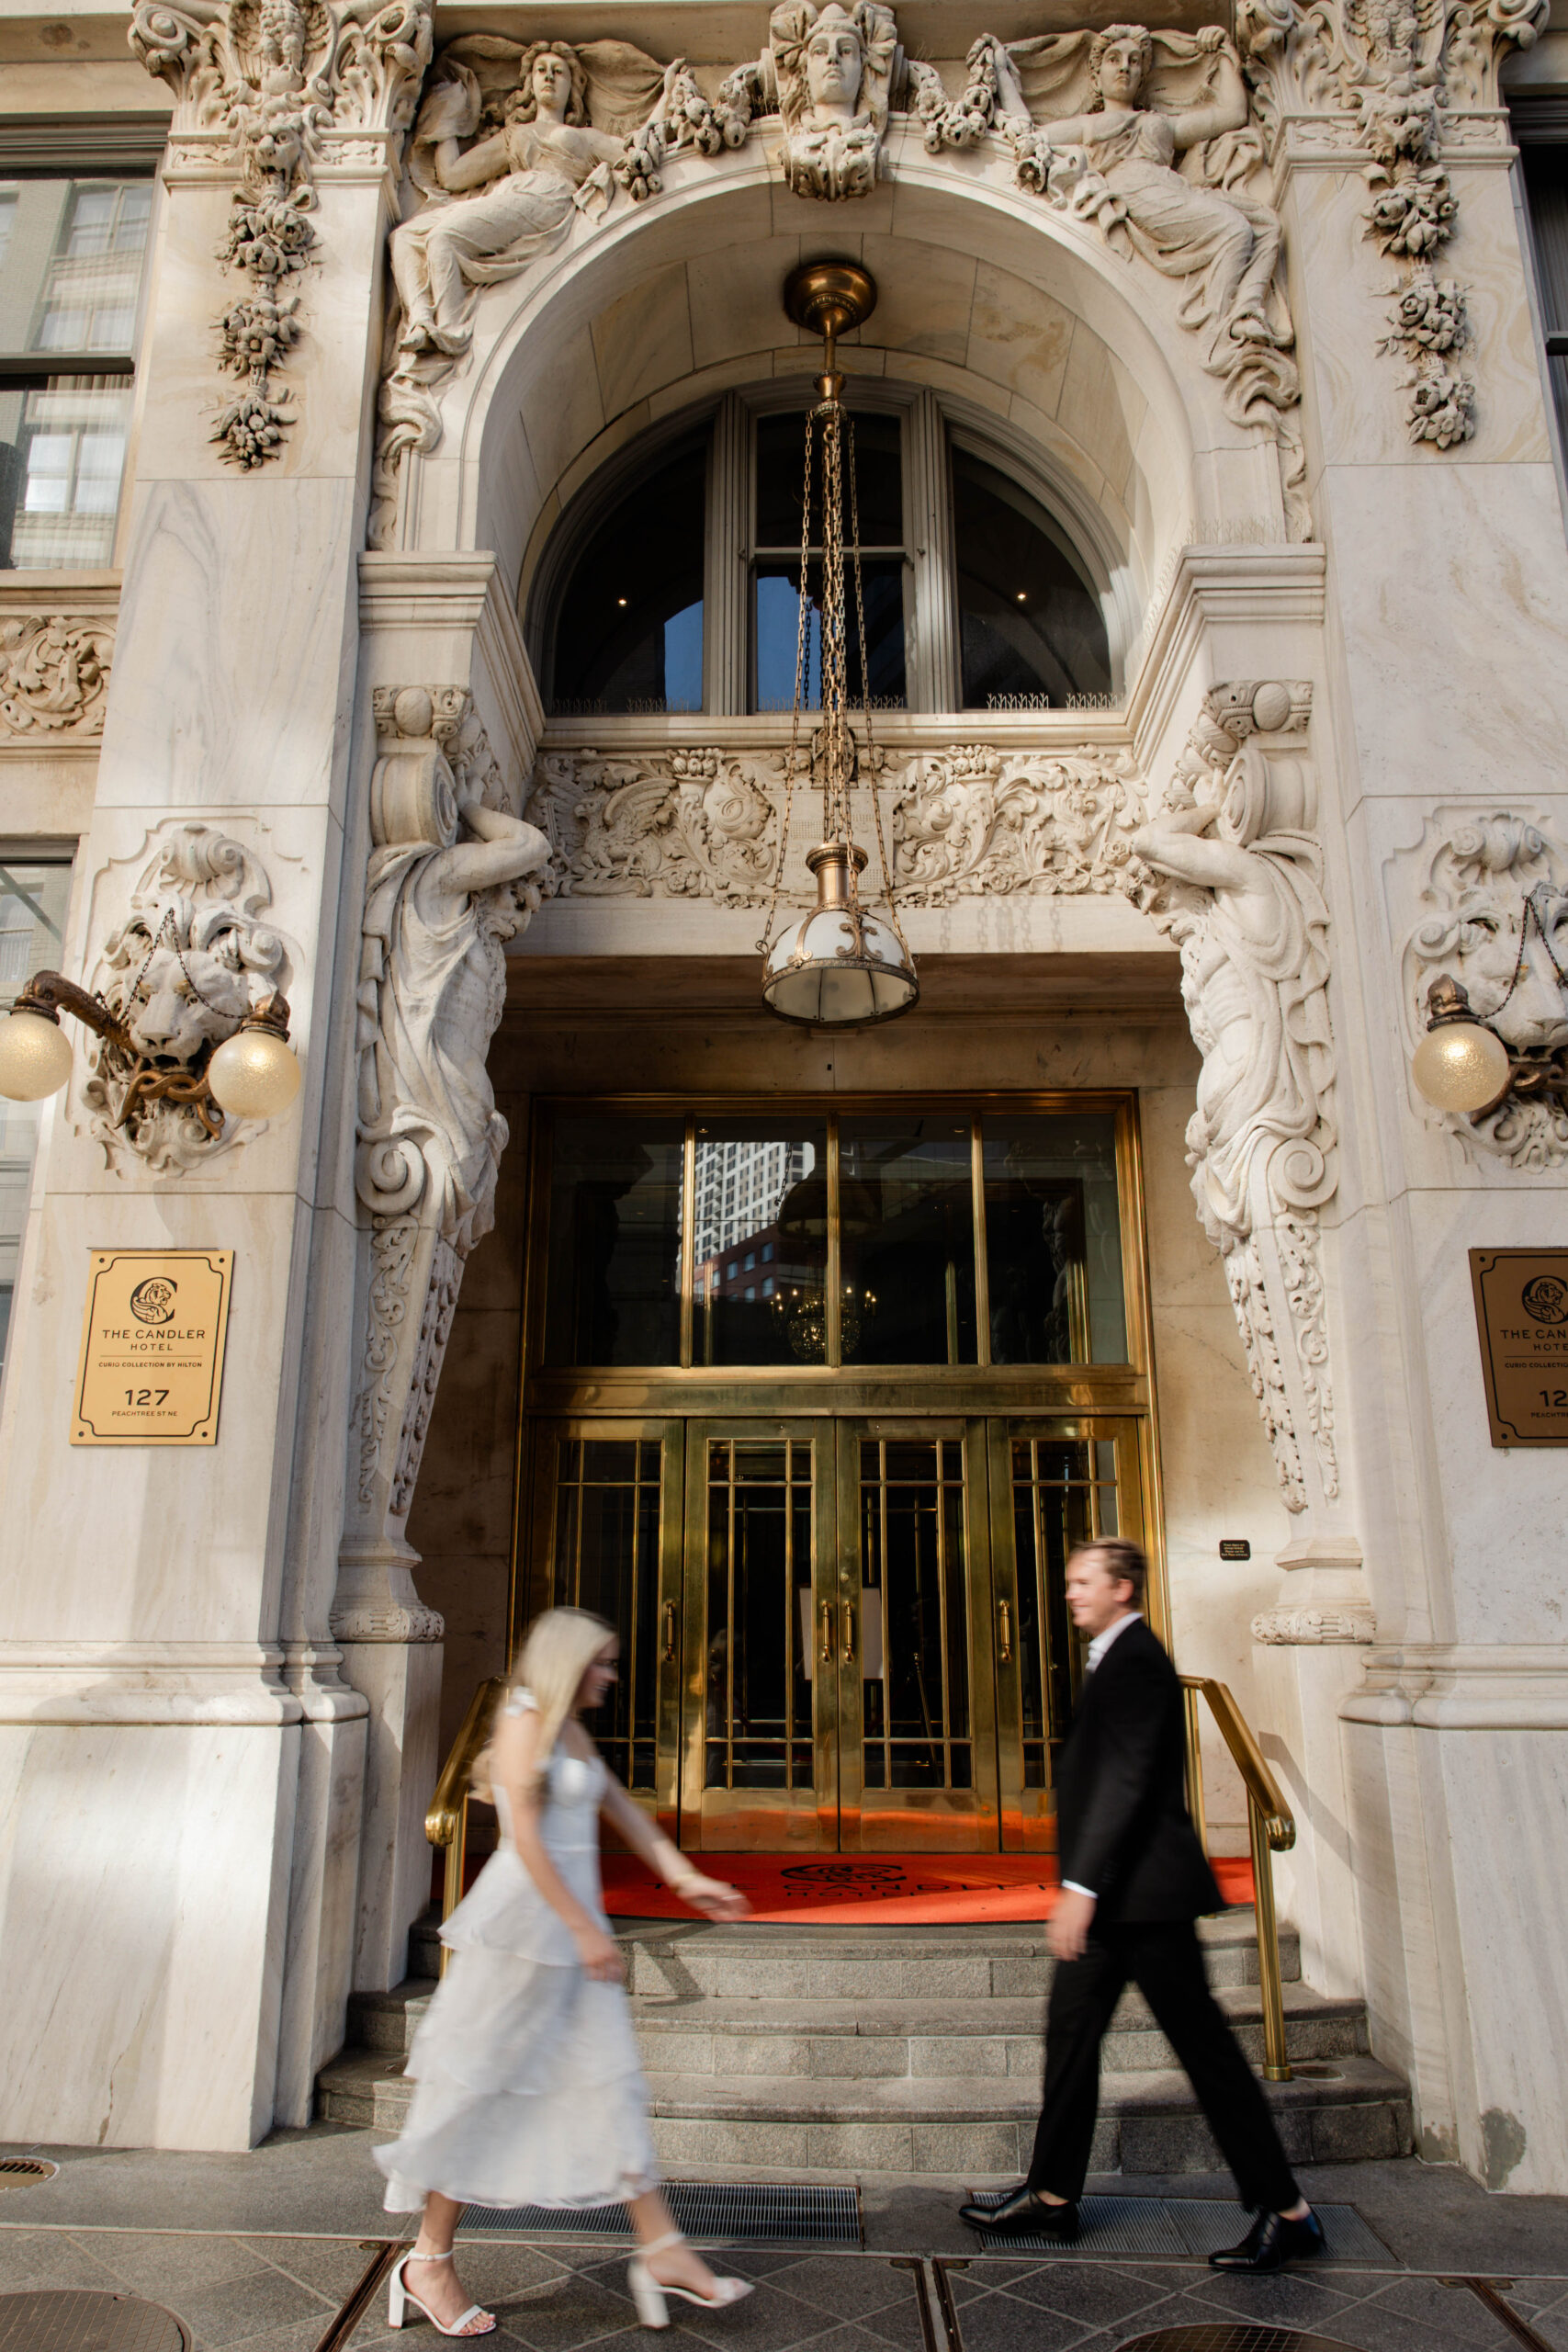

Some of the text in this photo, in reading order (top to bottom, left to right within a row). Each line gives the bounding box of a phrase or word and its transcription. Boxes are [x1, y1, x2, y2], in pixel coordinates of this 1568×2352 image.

[102, 1329, 206, 1340] THE CANDLER
[1500, 1329, 1531, 1340] THE
[130, 1343, 174, 1351] HOTEL
[125, 1389, 170, 1407] 127
